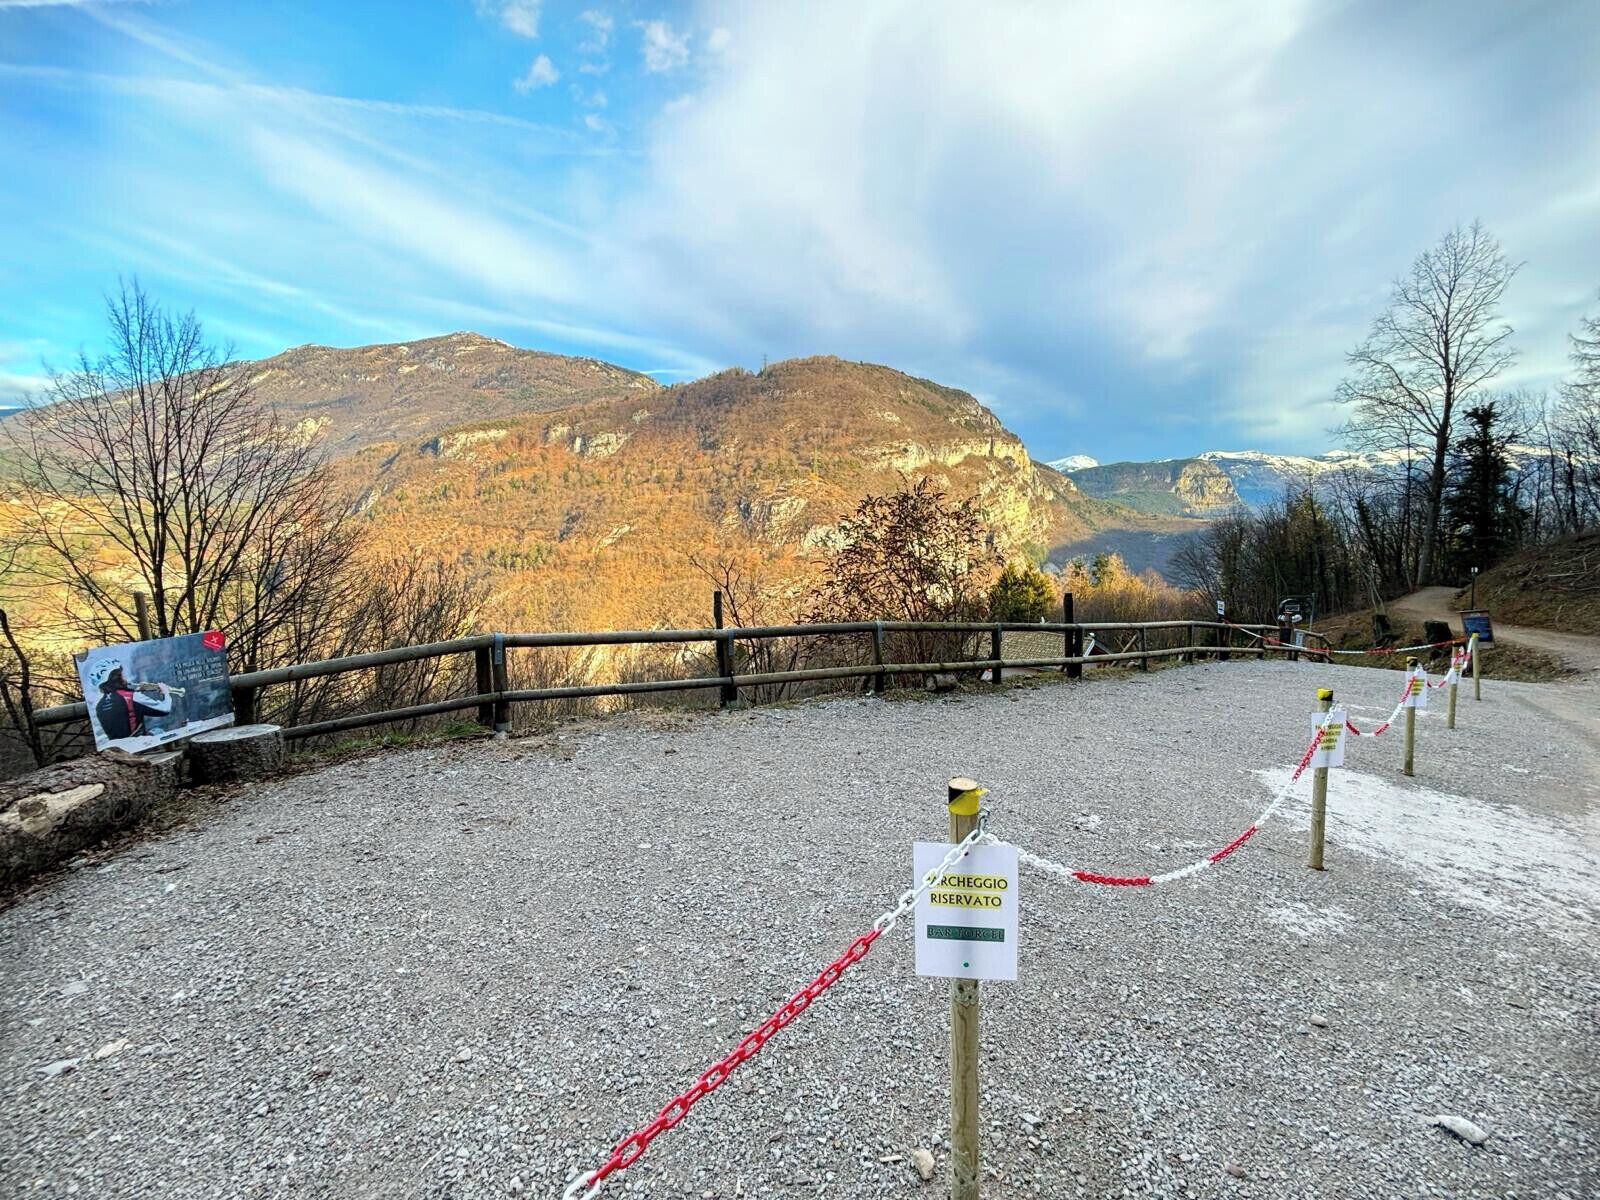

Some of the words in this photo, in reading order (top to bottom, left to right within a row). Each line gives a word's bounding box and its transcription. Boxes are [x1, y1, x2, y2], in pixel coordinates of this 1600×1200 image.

[927, 875, 1008, 890] RCHEGGIO
[930, 892, 1002, 907] RISERVATO
[927, 925, 951, 937] BAR
